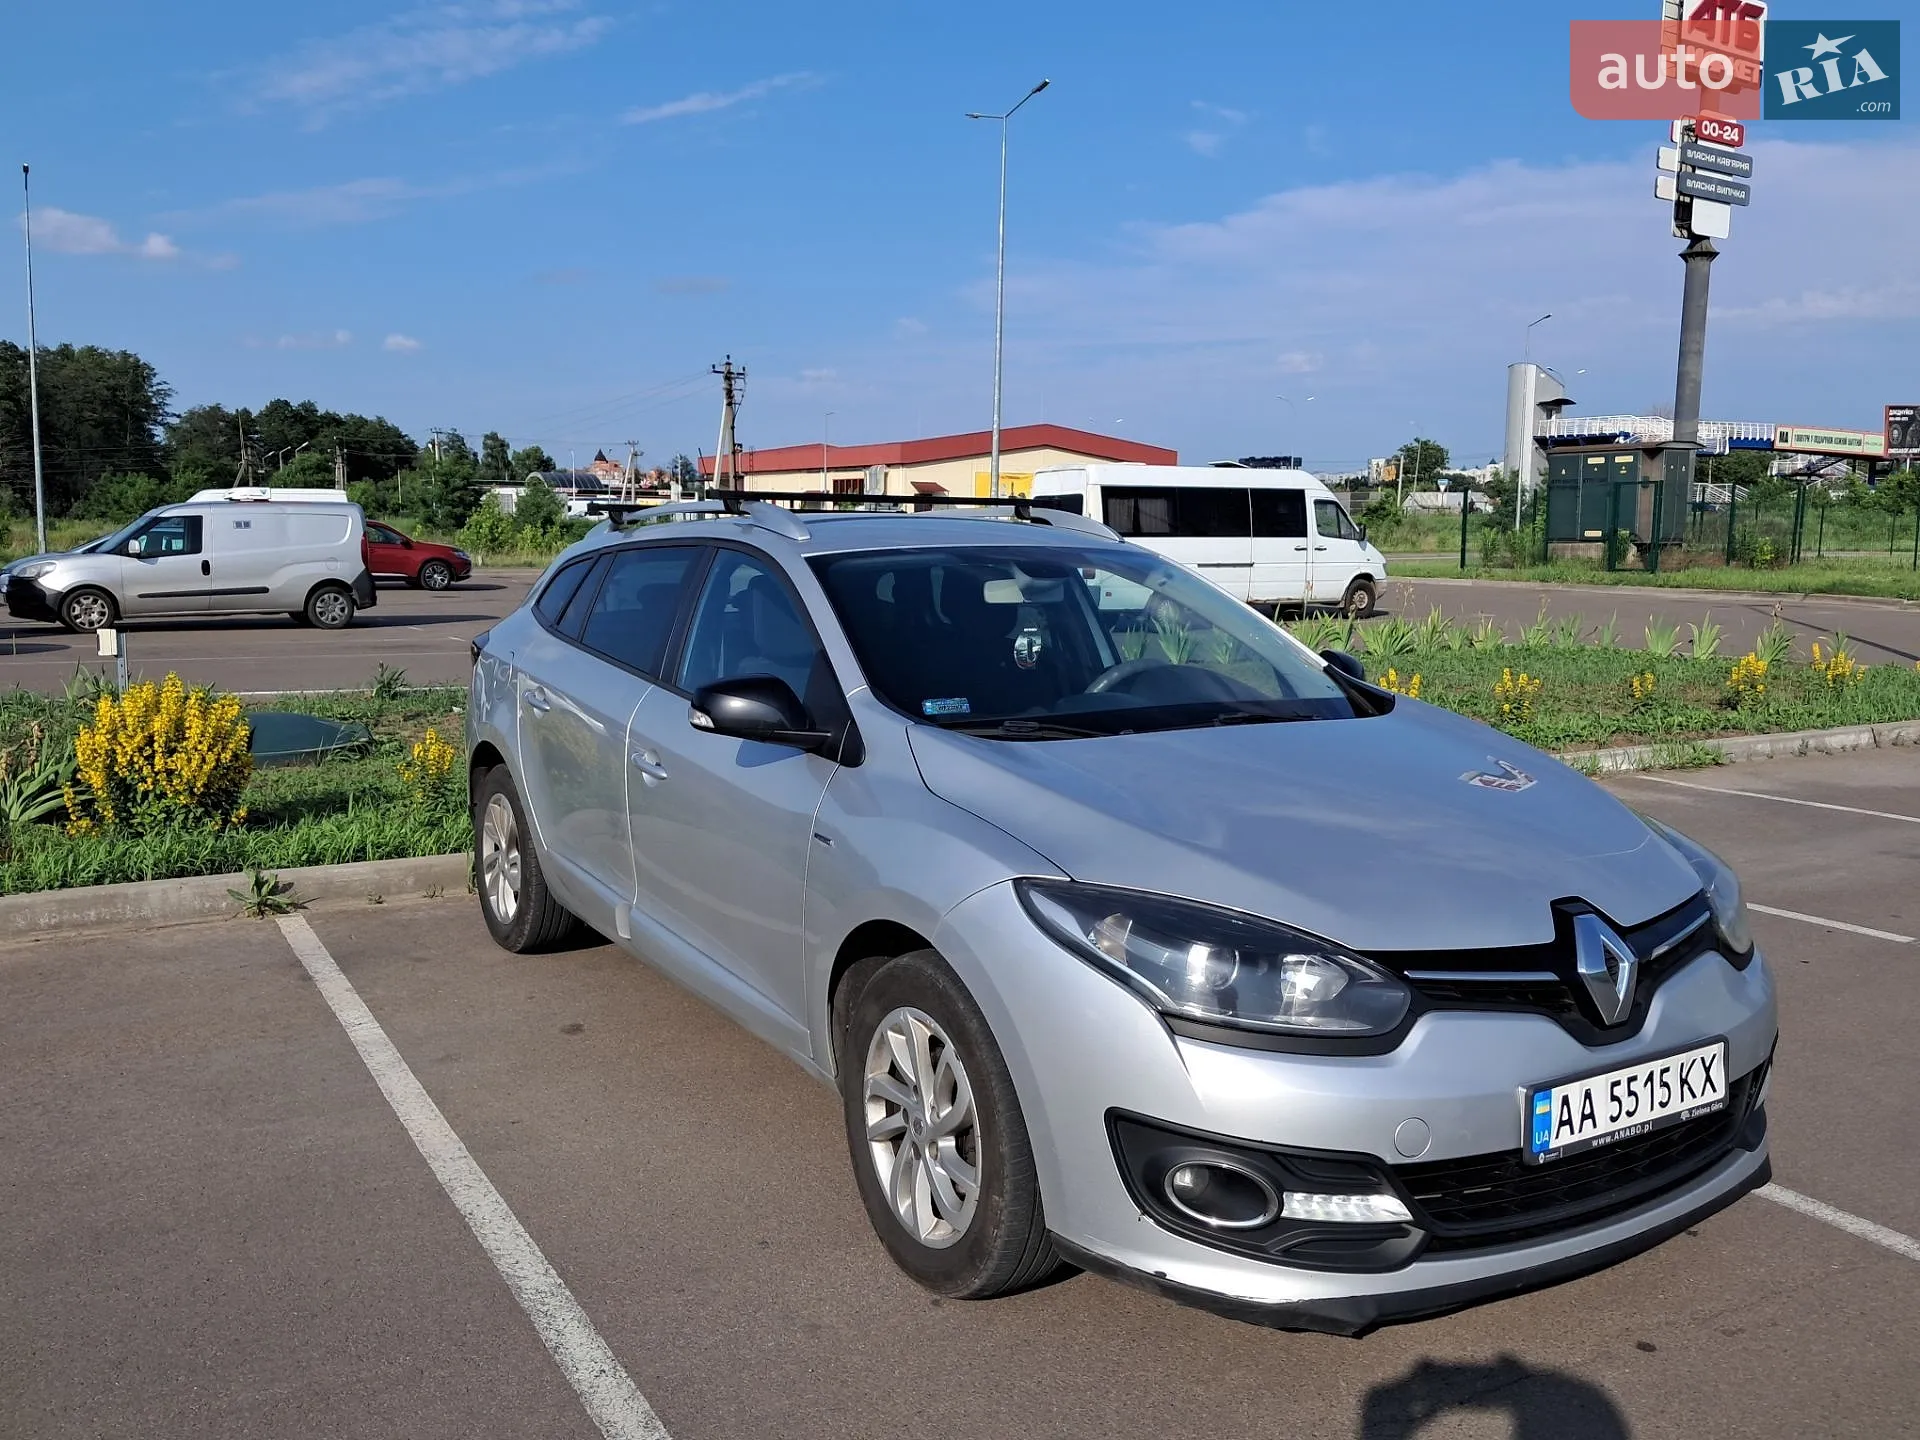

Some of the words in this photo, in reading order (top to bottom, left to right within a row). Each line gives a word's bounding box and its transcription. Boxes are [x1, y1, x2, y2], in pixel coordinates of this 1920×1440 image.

[1701, 120, 1740, 142] 00-24
[1686, 149, 1716, 163] ВЛАСНА
[1686, 178, 1716, 192] ВЛАСНА
[1555, 1088, 1598, 1140] AA
[1608, 1065, 1672, 1124] 5515
[1679, 1053, 1718, 1103] KX
[1535, 1129, 1550, 1145] UA
[1591, 1120, 1653, 1148] www.ANABO.pl
